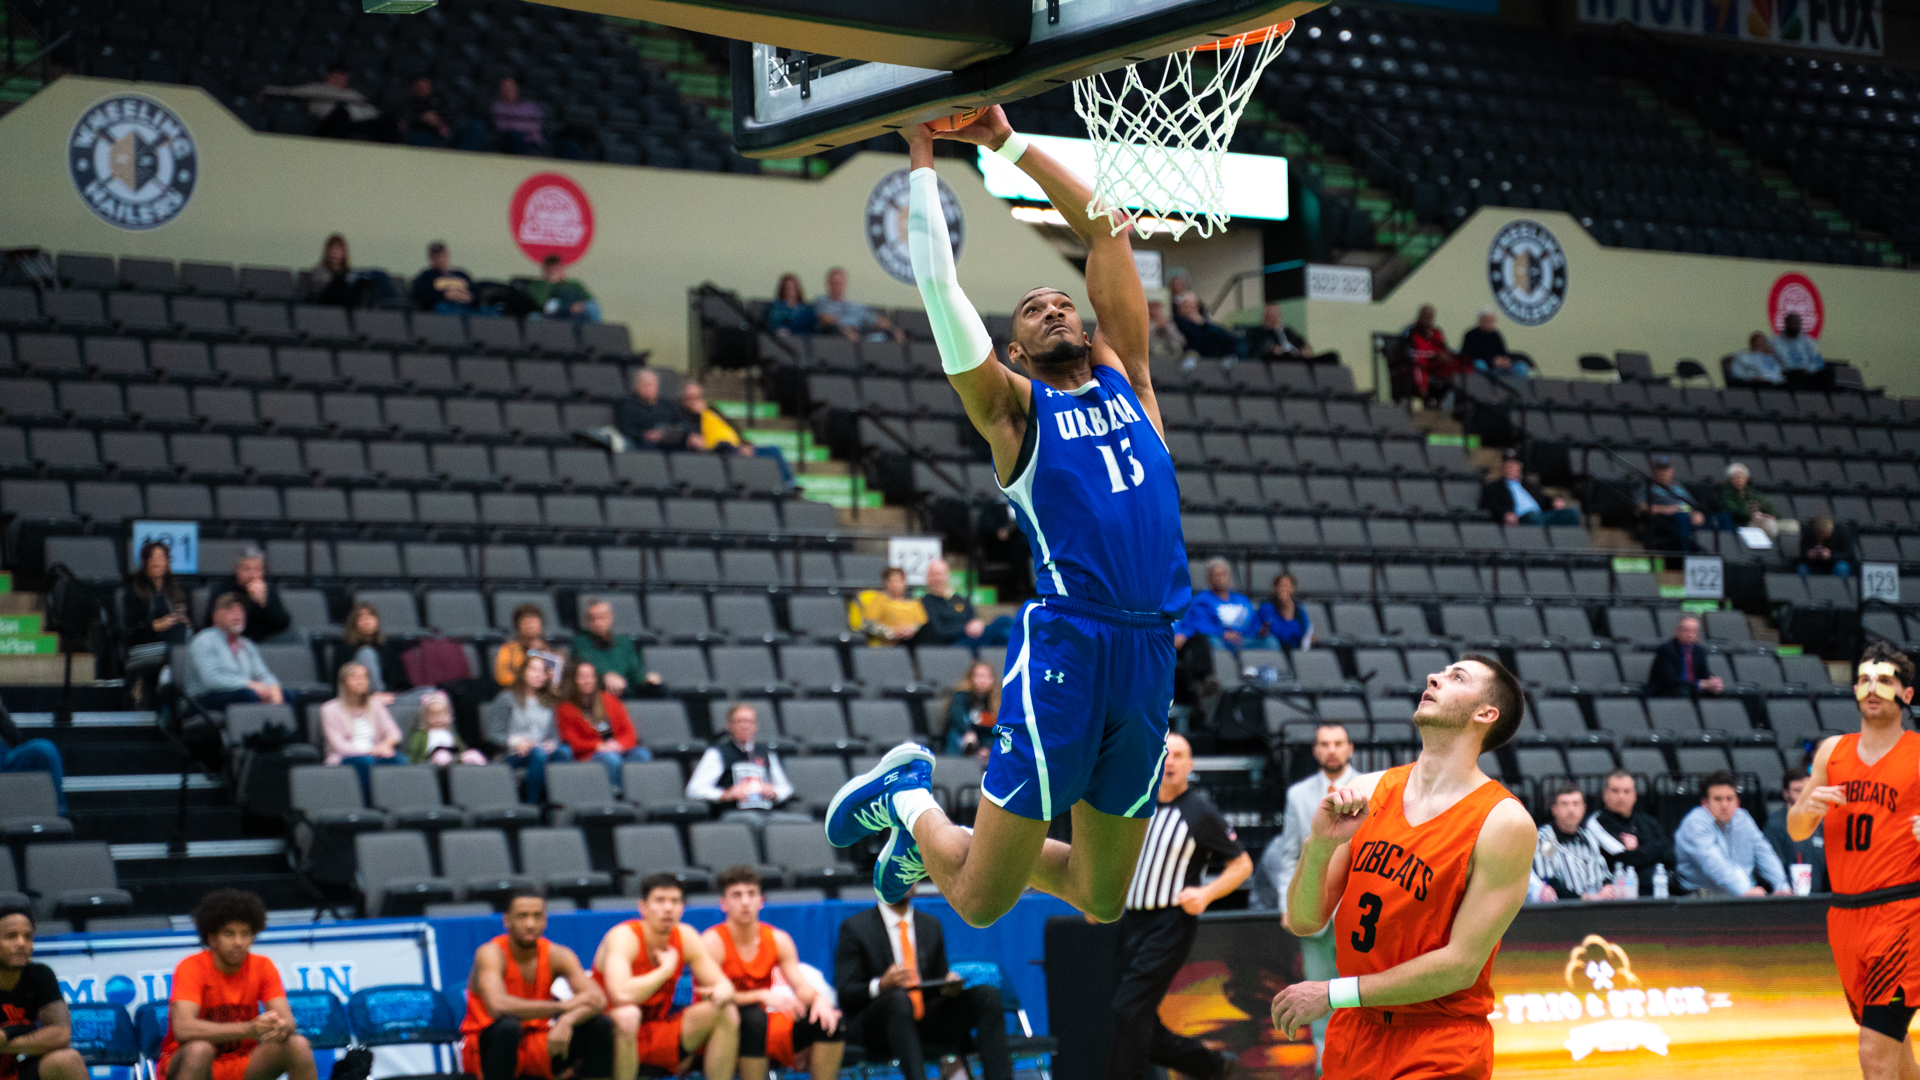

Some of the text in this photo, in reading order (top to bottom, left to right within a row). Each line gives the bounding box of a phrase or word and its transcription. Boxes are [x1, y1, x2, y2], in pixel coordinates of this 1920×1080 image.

[74, 99, 192, 159] WHEELING
[85, 179, 185, 223] HAILERS
[1095, 437, 1145, 494] 13
[1691, 566, 1719, 590] 122
[1867, 571, 1896, 592] 123
[1845, 812, 1874, 852] 10
[1350, 891, 1383, 954] 3
[1606, 986, 1710, 1019] STACK
